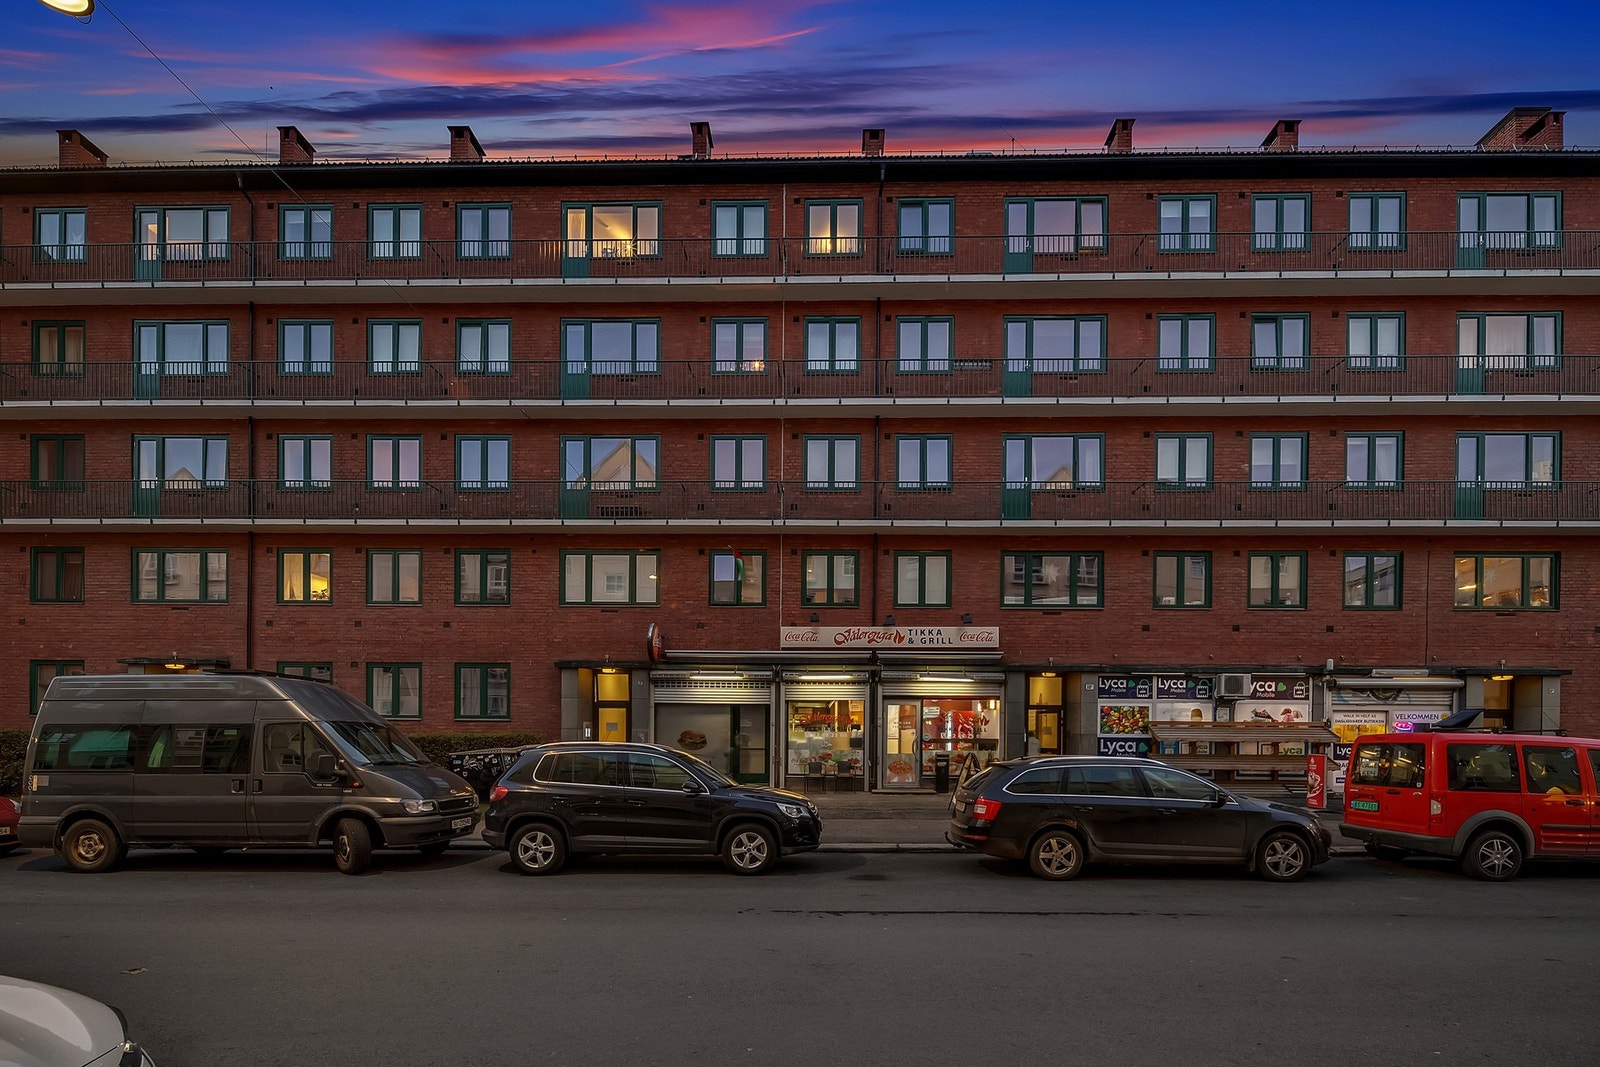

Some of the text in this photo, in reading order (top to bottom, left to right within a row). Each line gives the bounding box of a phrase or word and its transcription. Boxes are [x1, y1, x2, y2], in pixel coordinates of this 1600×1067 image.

[907, 628, 942, 637] TIKKA
[907, 636, 953, 645] & GRILL
[1099, 677, 1127, 690] Lyca
[1158, 677, 1187, 690] Lyca
[1250, 681, 1276, 694] yca
[1100, 739, 1137, 755] Lyca
[1337, 746, 1352, 755] Lyc
